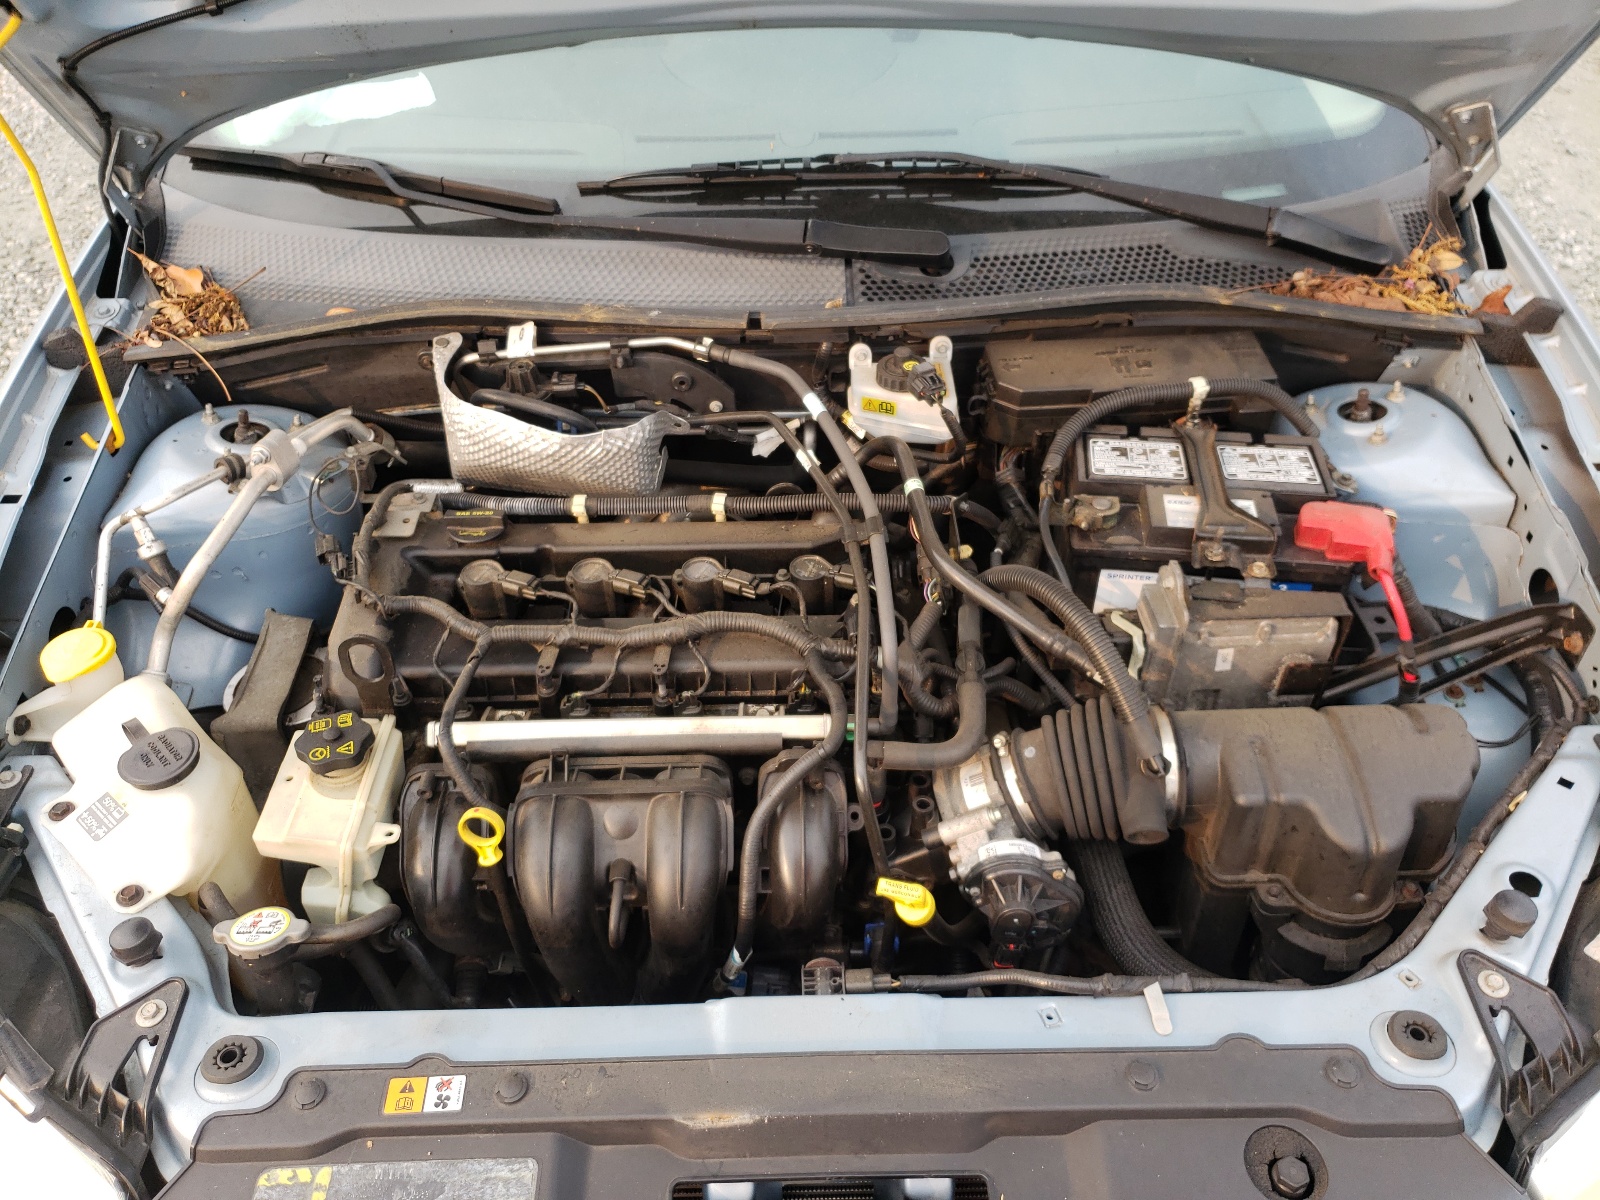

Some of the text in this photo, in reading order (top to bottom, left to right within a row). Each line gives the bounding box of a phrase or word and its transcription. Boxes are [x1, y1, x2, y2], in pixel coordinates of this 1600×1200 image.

[1107, 572, 1152, 581] SPRINTER
[147, 741, 171, 768] COOLANT
[157, 734, 183, 762] RADIATOR
[885, 880, 903, 890] TRANS
